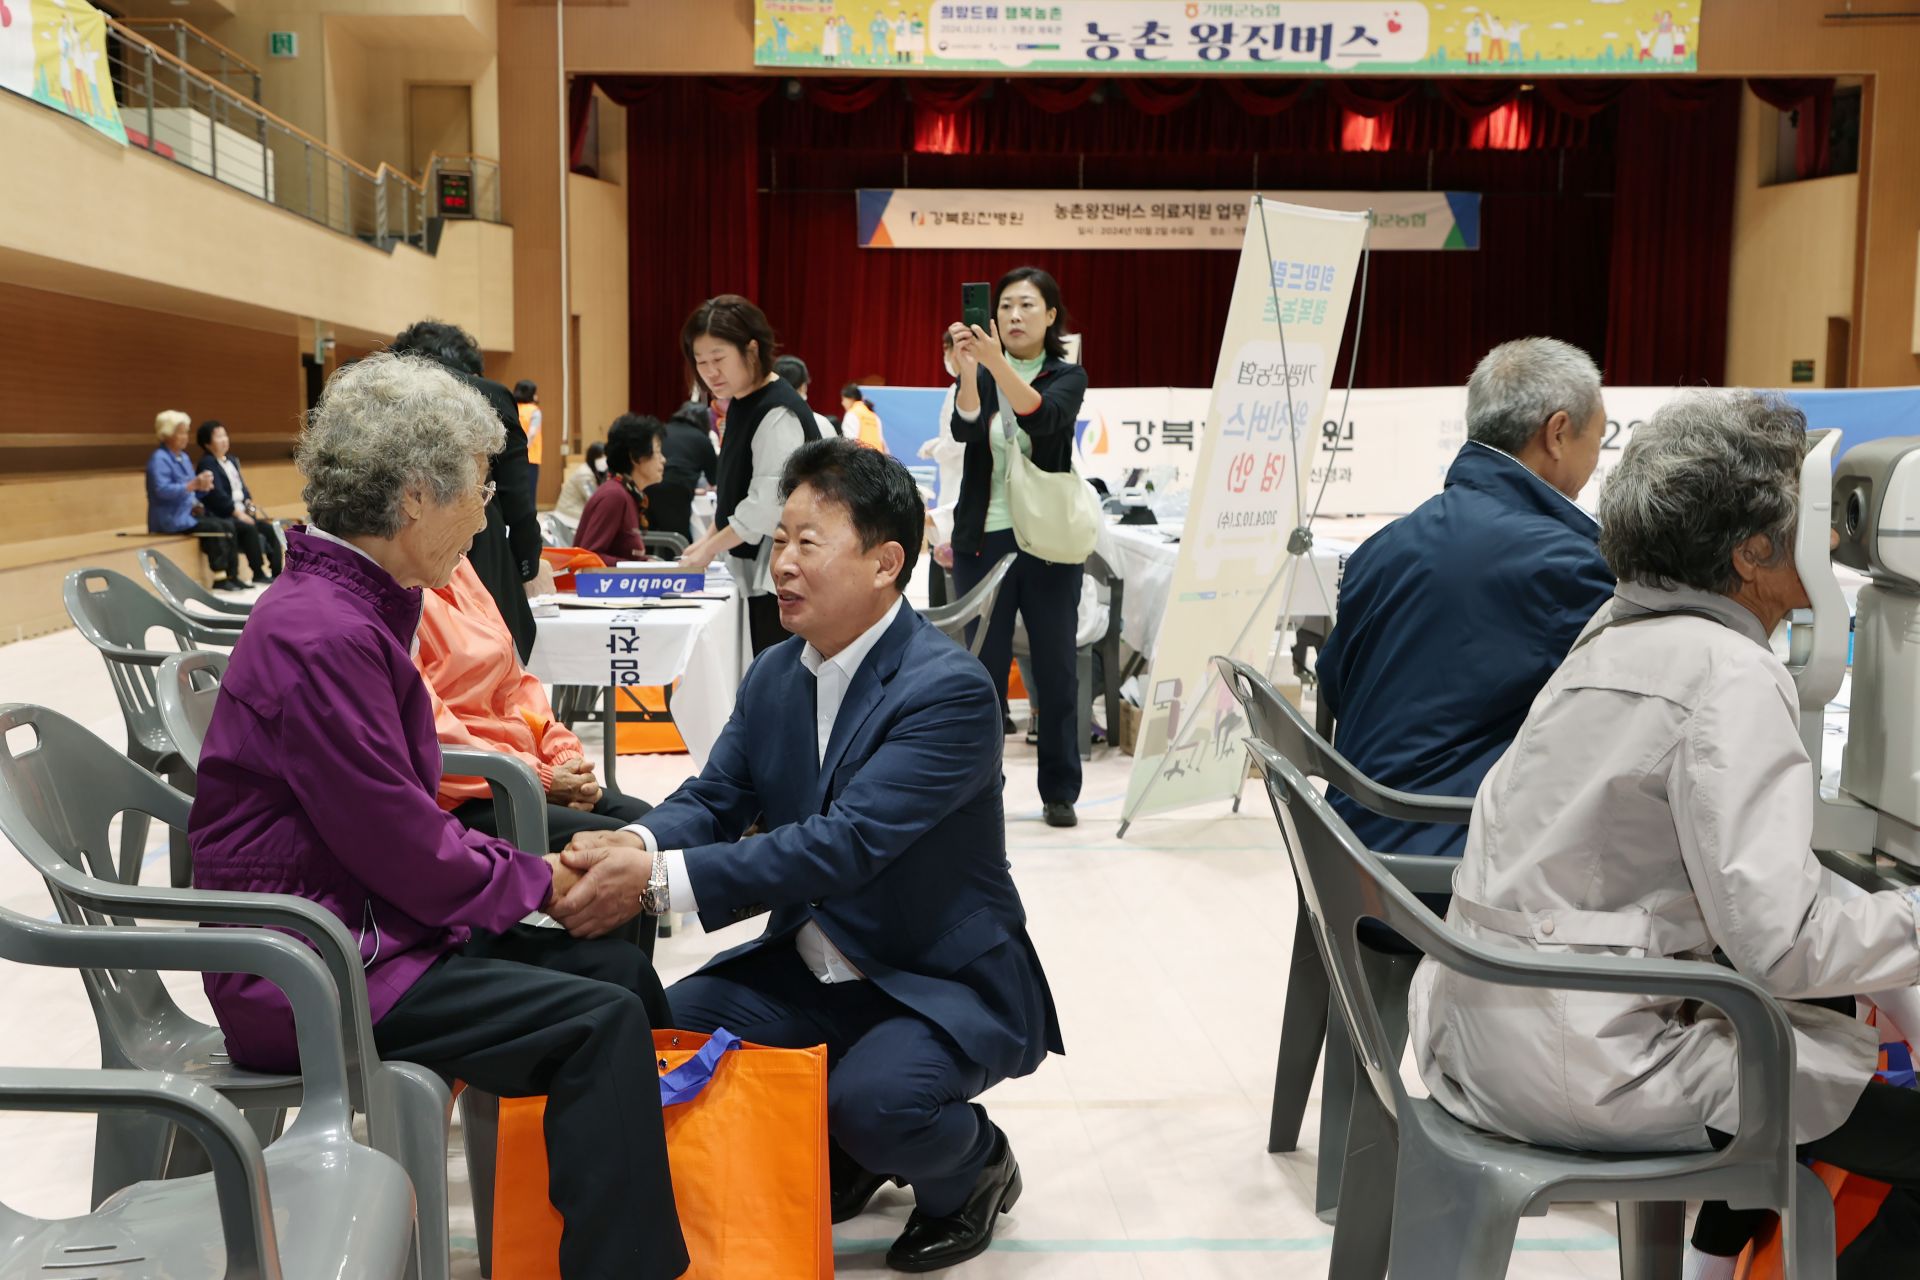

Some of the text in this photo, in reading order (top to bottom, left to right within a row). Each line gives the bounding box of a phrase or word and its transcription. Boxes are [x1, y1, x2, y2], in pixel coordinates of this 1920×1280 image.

[941, 5, 1062, 21] 희망드림 행복농촌
[1081, 20, 1382, 62] 농촌 왕진버스
[1054, 202, 1146, 220] 농촌왕진버스
[1151, 202, 1212, 220] 의료지원
[600, 578, 687, 593] Double A
